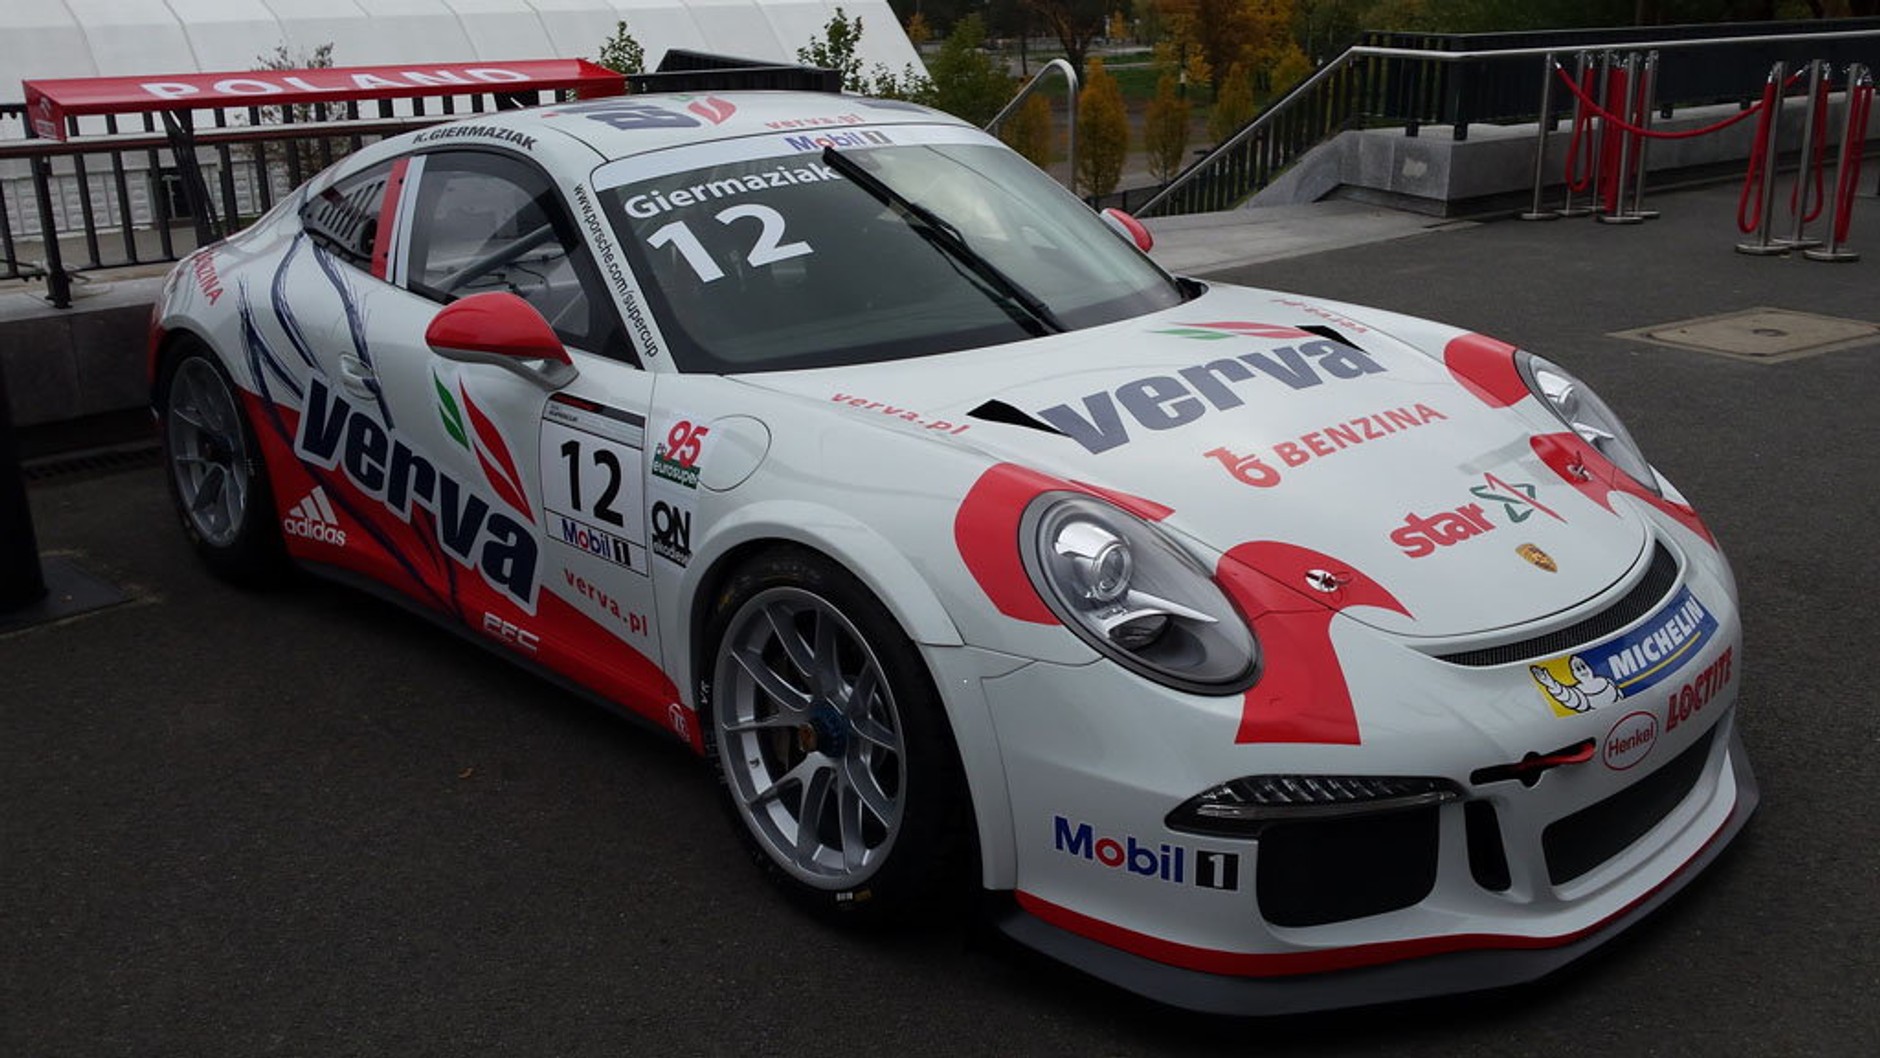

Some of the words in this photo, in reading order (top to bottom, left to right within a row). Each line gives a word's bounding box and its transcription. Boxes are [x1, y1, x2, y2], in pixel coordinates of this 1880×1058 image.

[140, 69, 532, 99] POLAND
[412, 126, 538, 151] K.GIERMAZIAK
[784, 132, 869, 151] Mobil
[624, 163, 843, 219] Giermaziak
[572, 184, 659, 357] www.porsche.com/supercup
[646, 203, 814, 284] 12
[832, 393, 970, 435] verva.pl
[1037, 338, 1388, 455] verva
[663, 420, 709, 468] 95
[1273, 403, 1448, 468] BENZINA
[300, 377, 538, 606] verva
[561, 440, 624, 528] 12
[284, 518, 346, 547] adidas
[561, 518, 611, 558] Mobil
[1390, 502, 1496, 558] star
[564, 569, 648, 636] verva.pl
[1607, 595, 1705, 680] MICHELIN
[1665, 645, 1734, 734] LOCTITE
[1607, 722, 1655, 757] Henkel
[1054, 815, 1184, 883] Mobil
